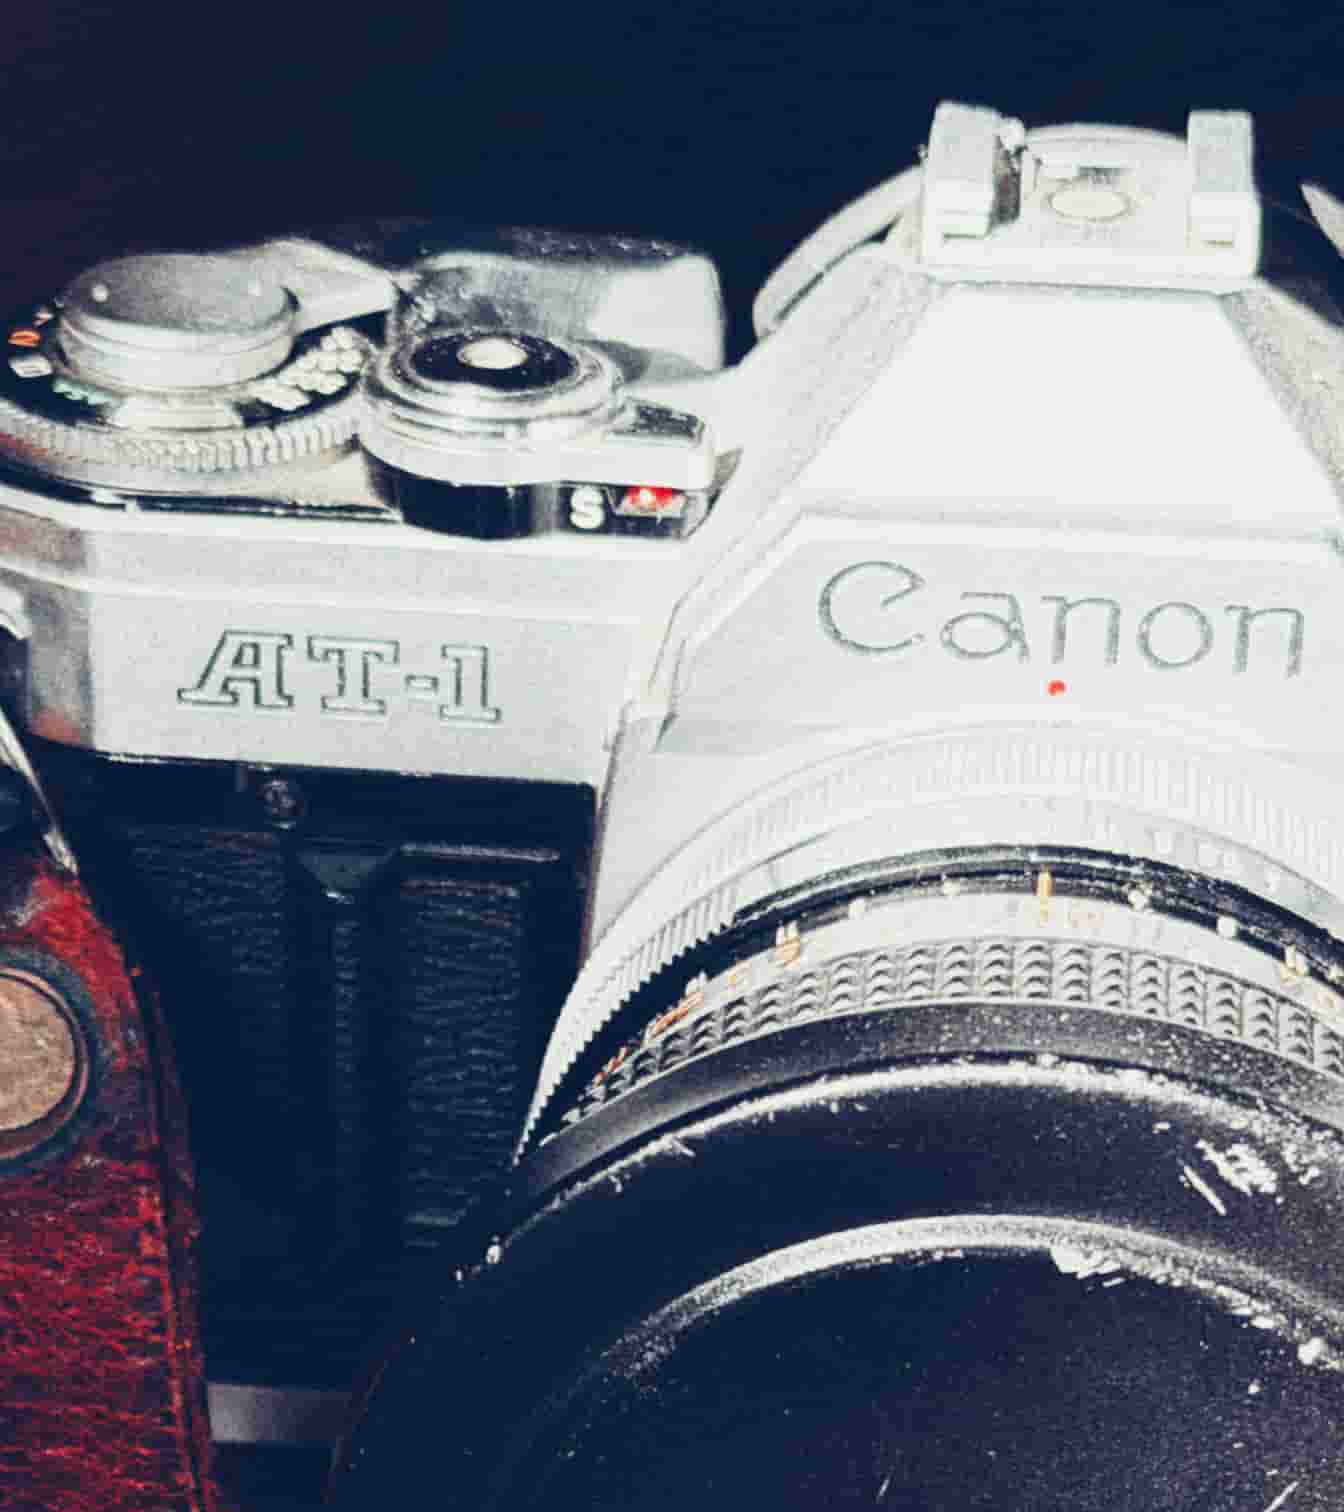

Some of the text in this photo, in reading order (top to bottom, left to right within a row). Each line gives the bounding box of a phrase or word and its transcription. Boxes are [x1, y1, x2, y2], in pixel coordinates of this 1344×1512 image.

[569, 485, 604, 530] S
[819, 559, 1305, 678] Canon
[176, 629, 503, 724] AT-1
